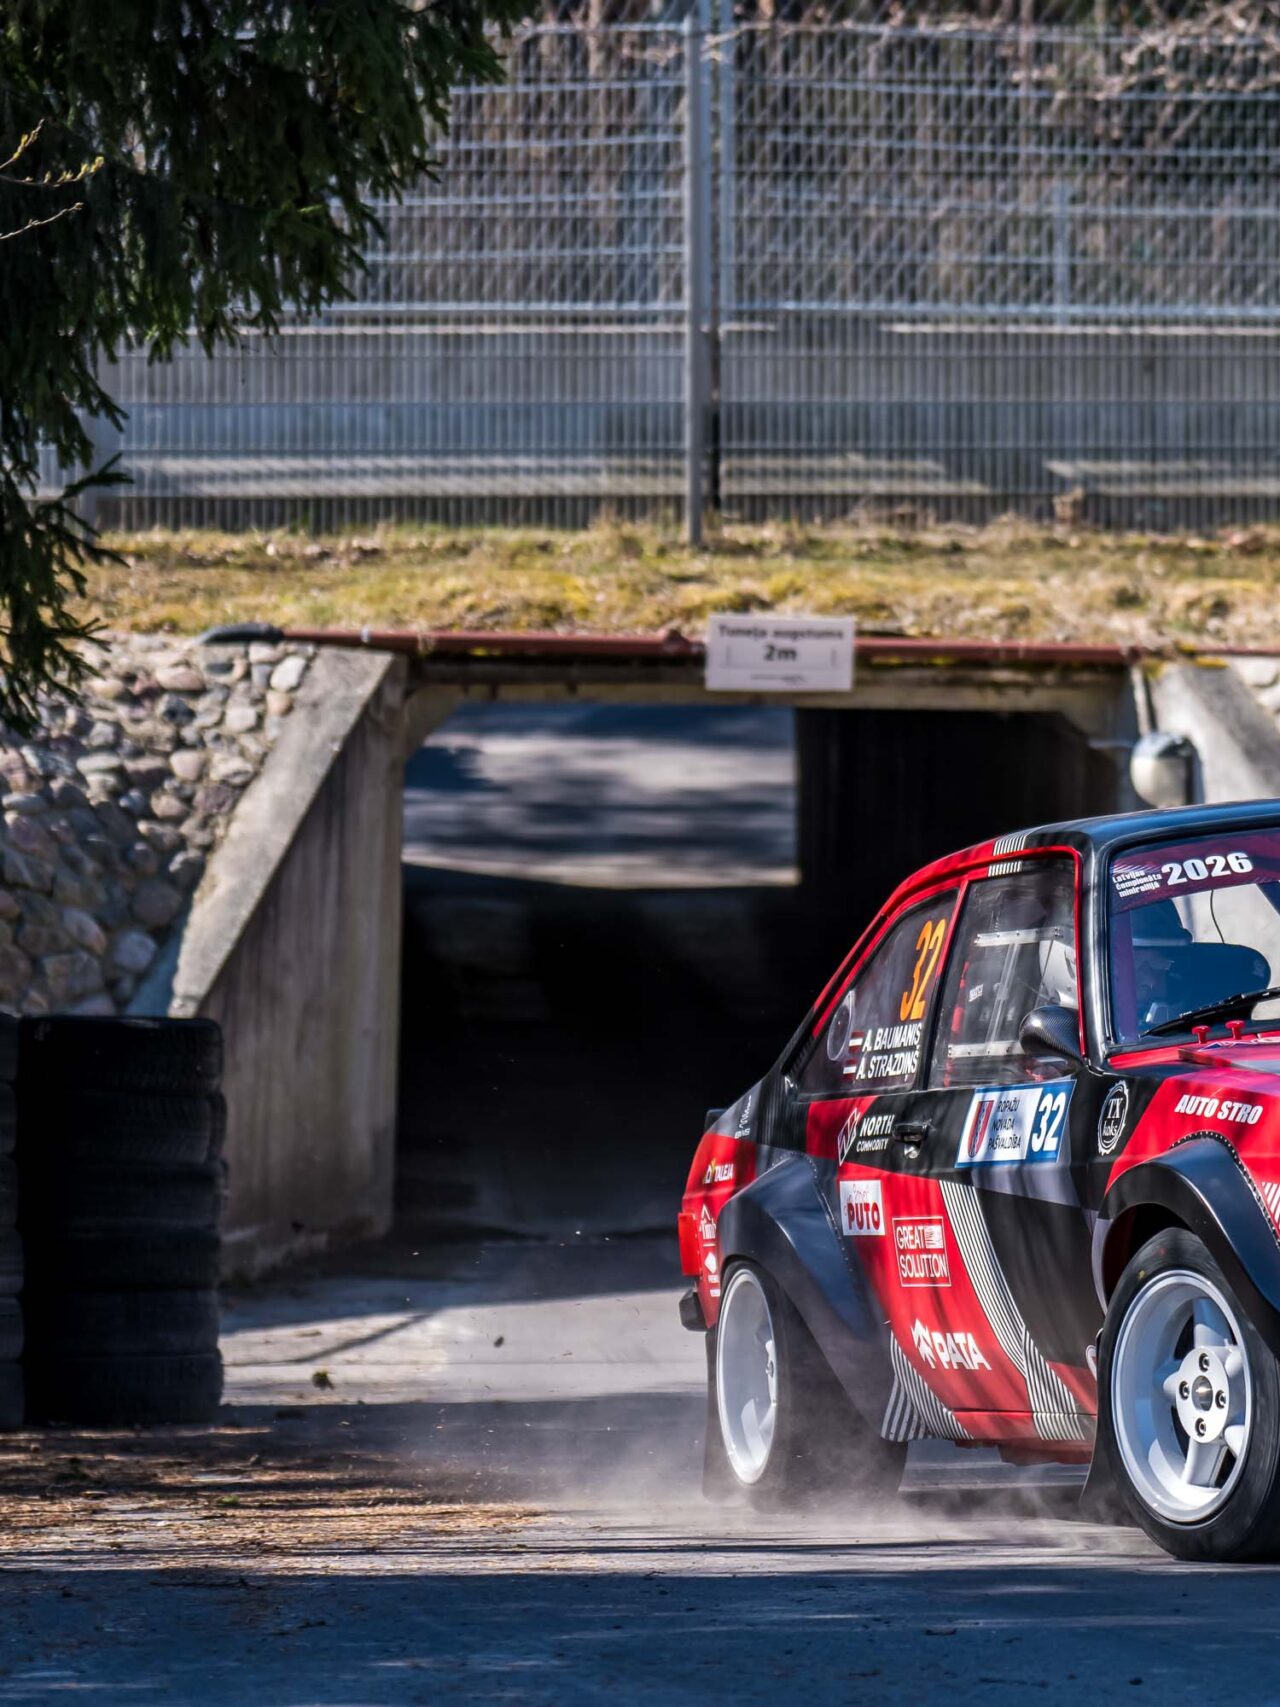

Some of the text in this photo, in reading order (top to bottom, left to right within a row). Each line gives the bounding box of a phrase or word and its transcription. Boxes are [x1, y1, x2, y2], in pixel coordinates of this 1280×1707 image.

[1161, 852, 1253, 886] 2026
[900, 919, 945, 1021] 32
[862, 1023, 922, 1052] A. BAUMANIS
[855, 1057, 866, 1080] A.
[1031, 1092, 1067, 1153] 32
[1174, 1094, 1264, 1125] AUTO STRO
[859, 1115, 896, 1137] NORTH
[856, 1138, 889, 1153] COMMODITY
[847, 1202, 880, 1230] PUTO
[896, 1225, 925, 1250] GREAT
[900, 1254, 948, 1278] SOLUTION
[931, 1331, 992, 1371] PATA
